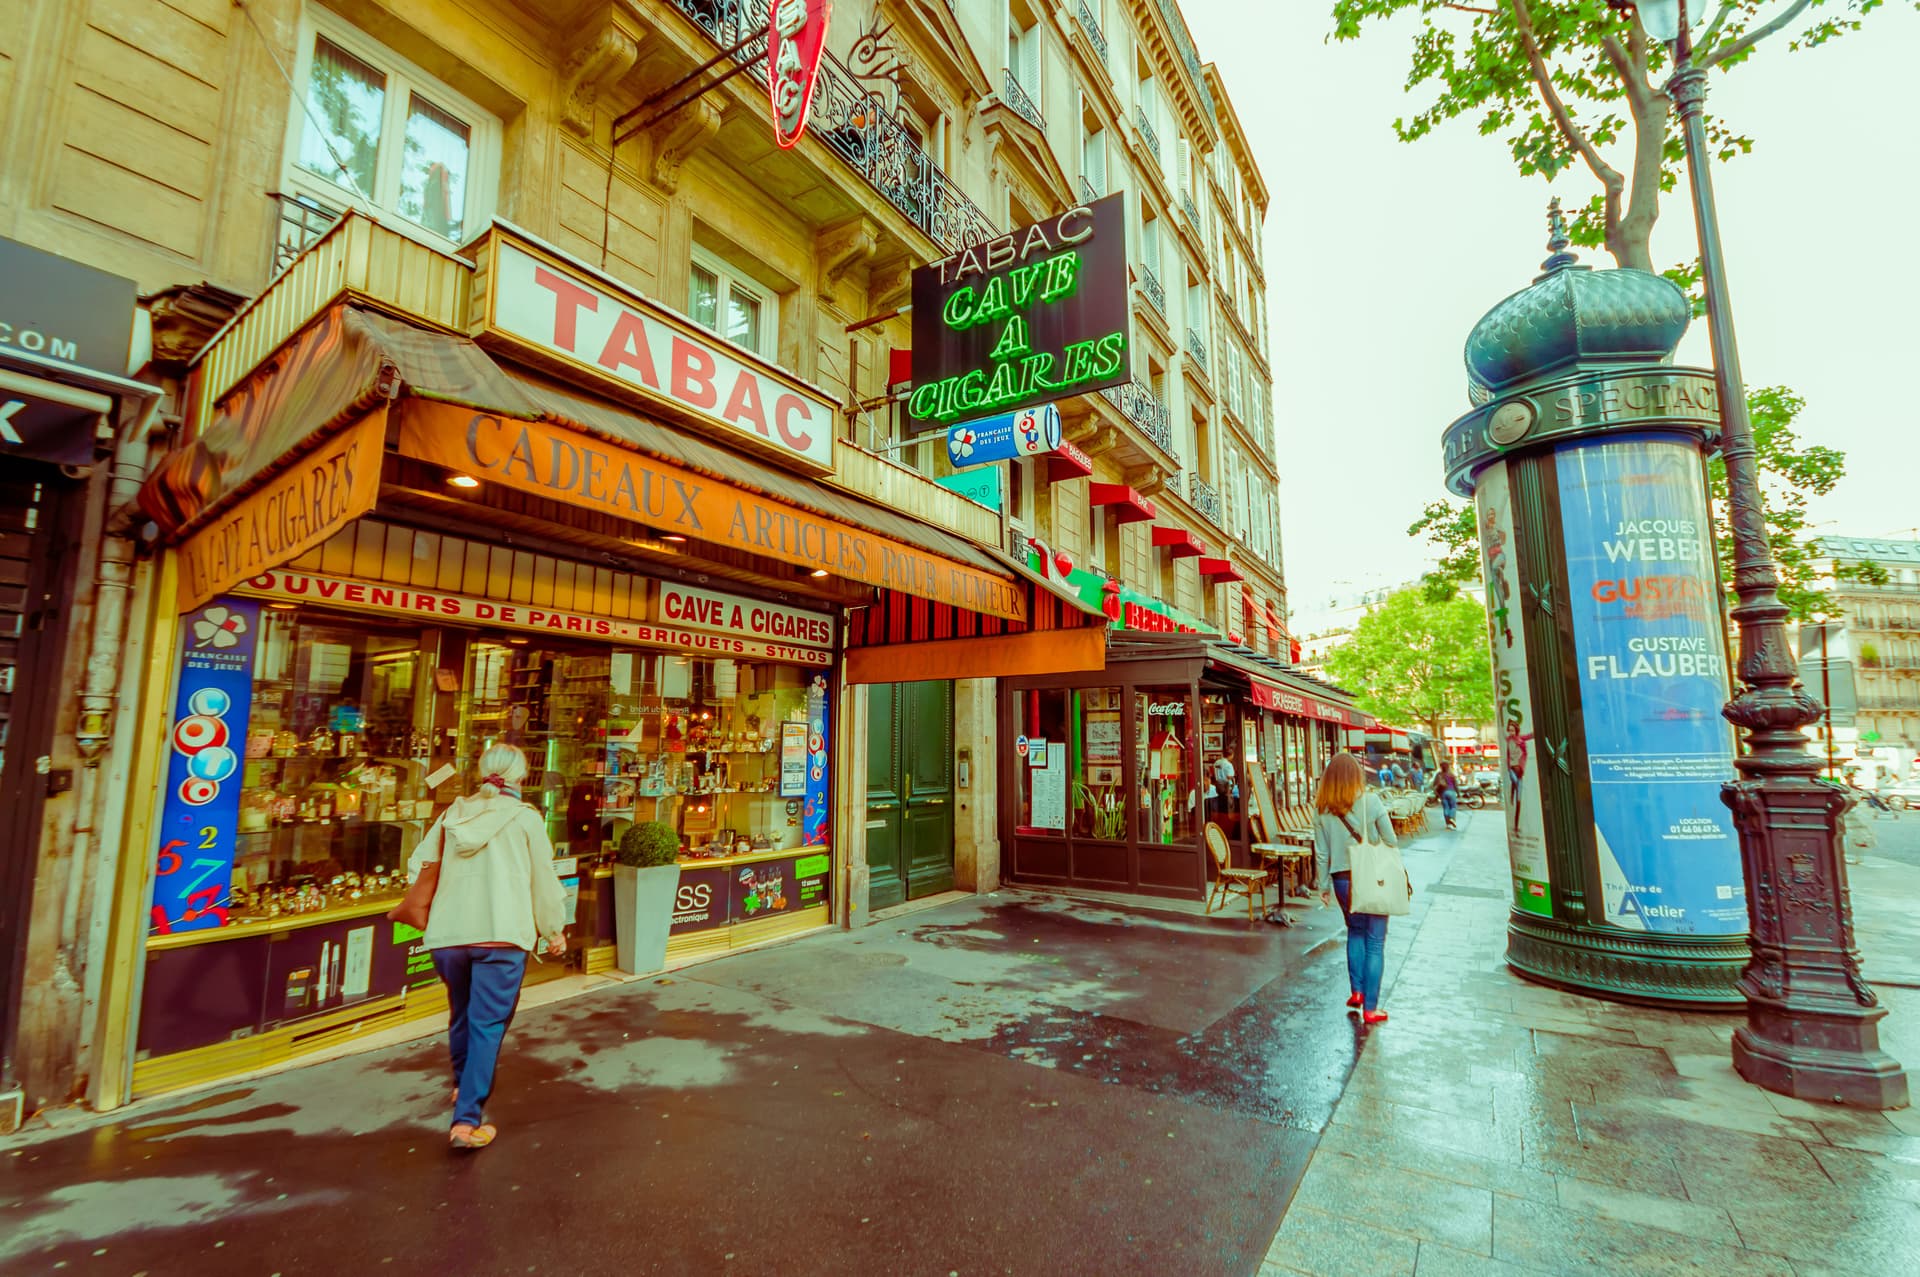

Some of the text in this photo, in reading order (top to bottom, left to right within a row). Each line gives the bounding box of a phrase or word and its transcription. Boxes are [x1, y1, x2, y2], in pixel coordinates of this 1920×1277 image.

[929, 207, 1094, 286] TABAC
[944, 251, 1077, 327] CAVE
[535, 266, 812, 451] TABAC
[990, 315, 1028, 358] A
[909, 333, 1122, 418] CIGARES
[994, 435, 1009, 444] JEUX
[248, 508, 263, 567] A
[265, 441, 357, 556] CIGARES
[466, 413, 1021, 616] CADEAUX ARTICLES POUR FUMEUR
[1615, 520, 1696, 536] JACQUES
[247, 573, 828, 663] OUVENIRS DE PARIS BRIQUETS STYLOS
[664, 591, 830, 644] CAVE A CIGARES
[213, 663, 243, 671] JEUX
[1627, 637, 1707, 651] GUSTAVE
[198, 826, 218, 849] 2
[177, 858, 226, 899] 7
[1649, 885, 1662, 893] de
